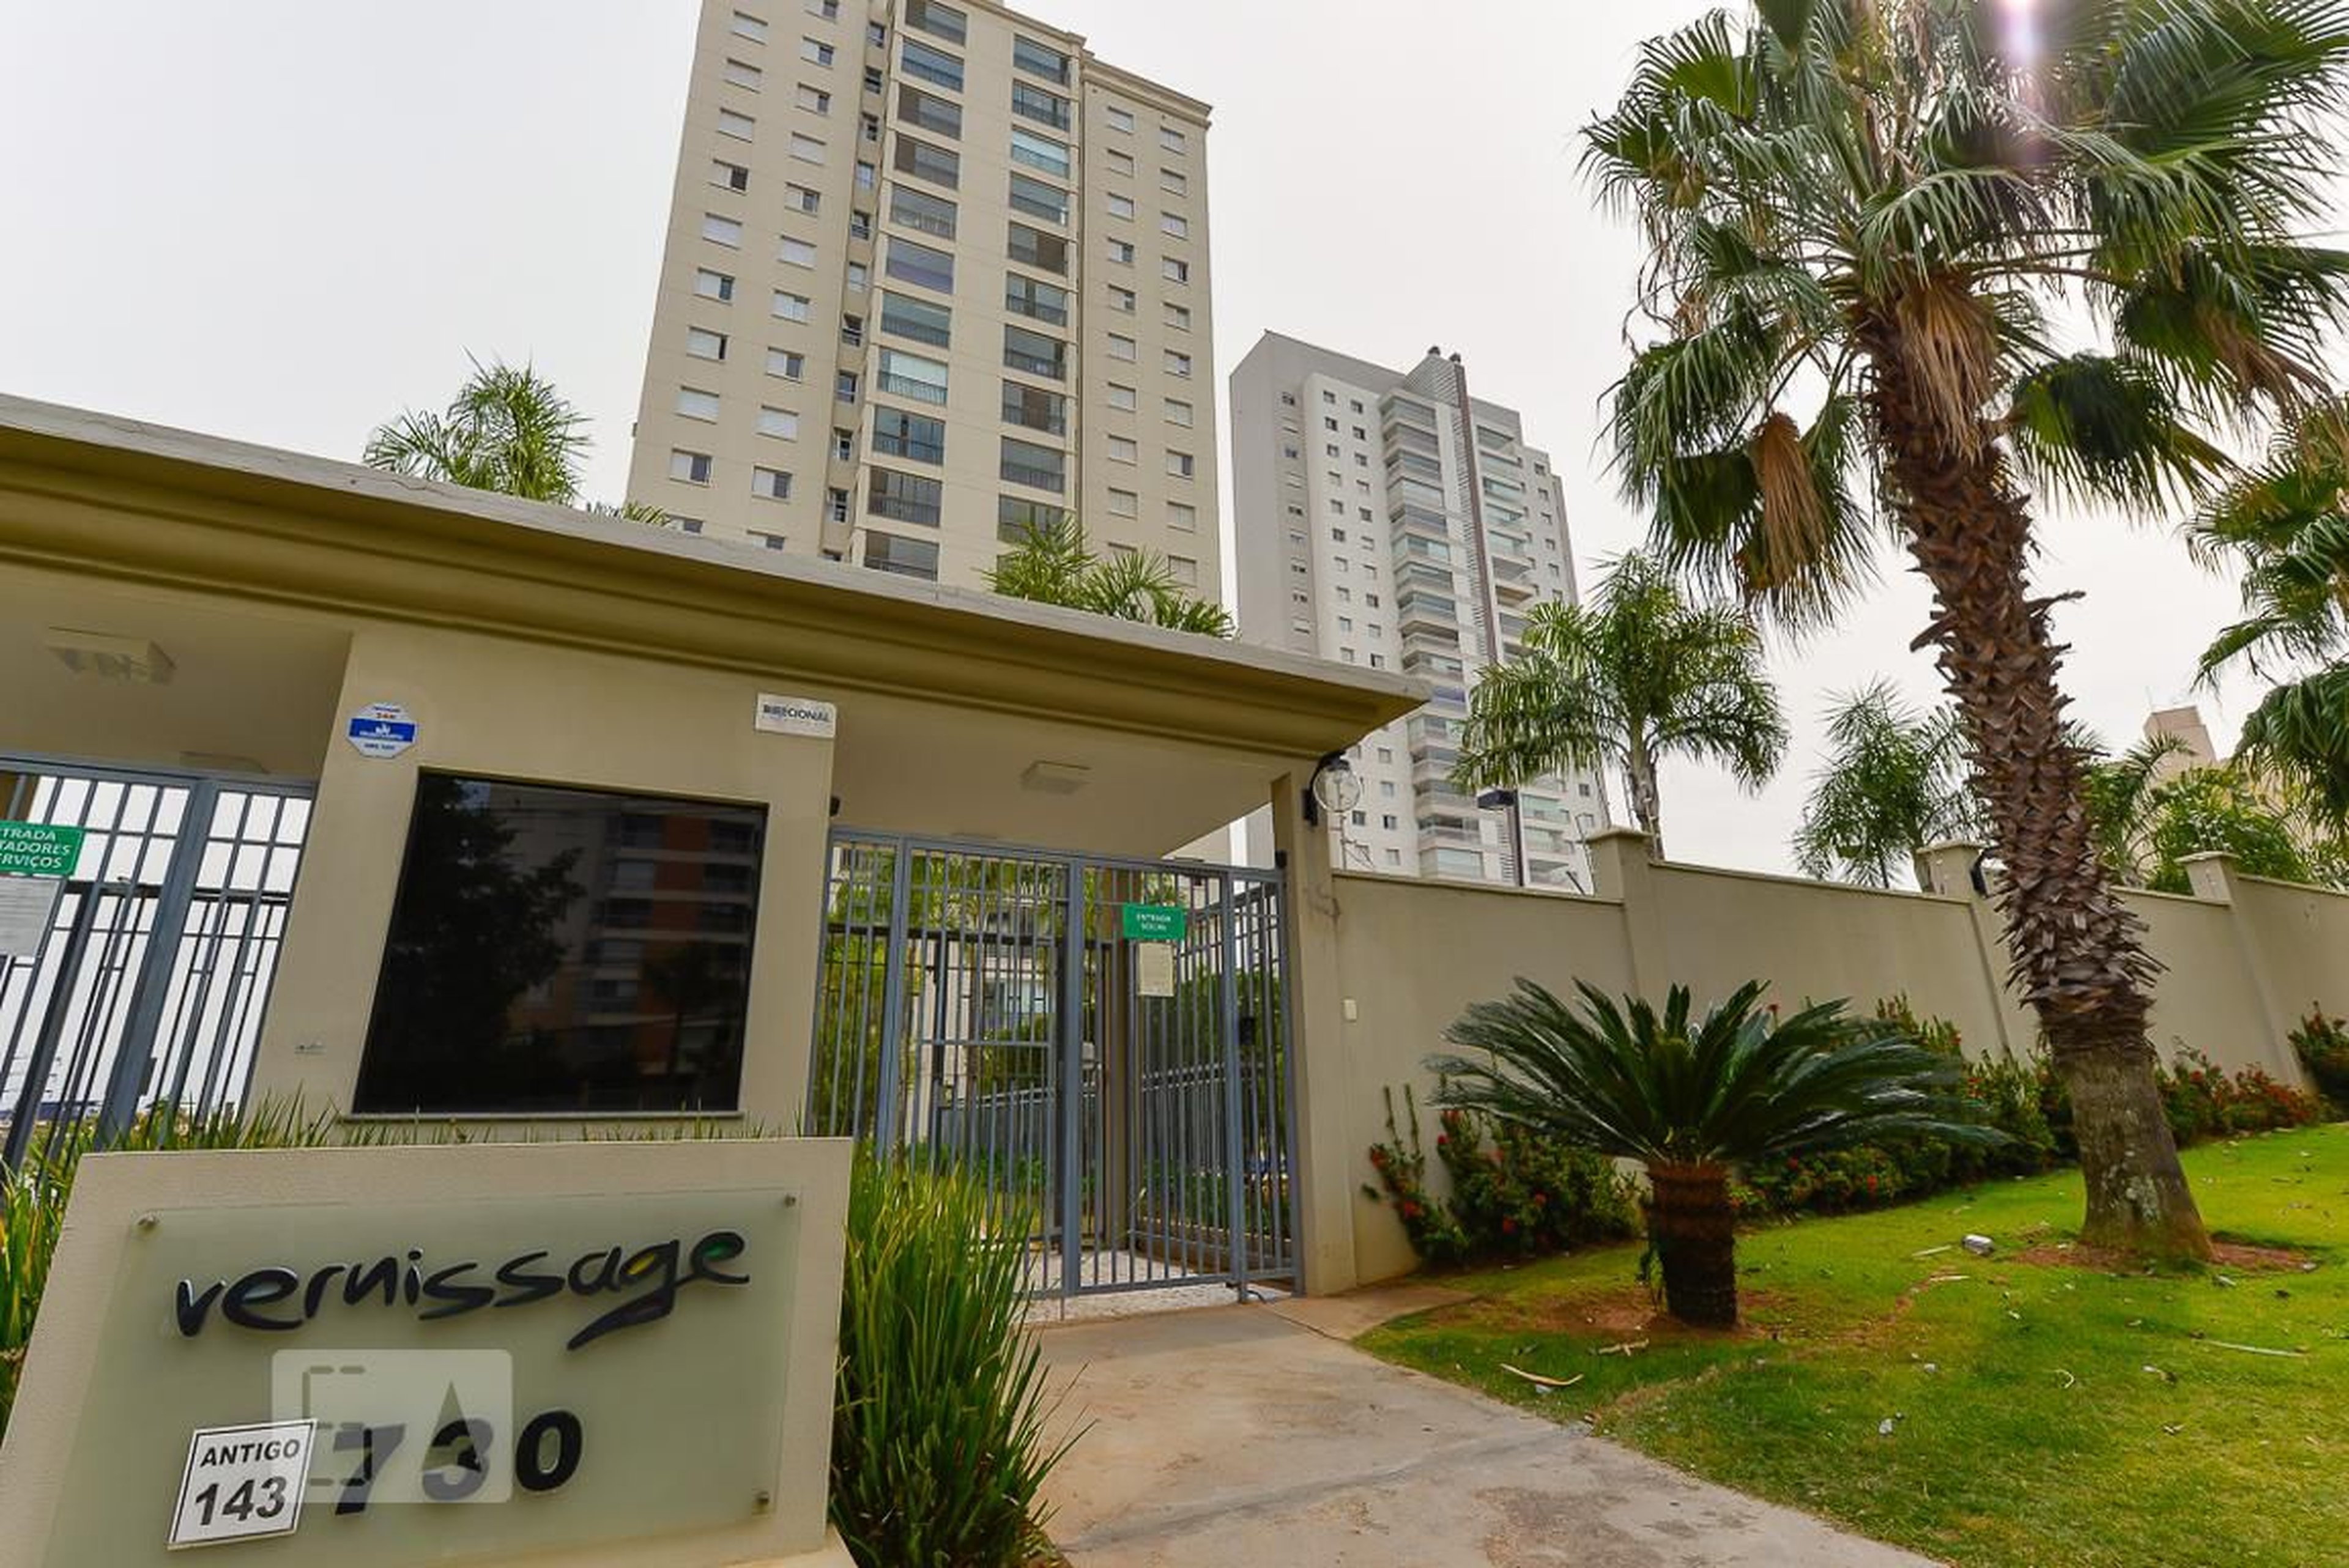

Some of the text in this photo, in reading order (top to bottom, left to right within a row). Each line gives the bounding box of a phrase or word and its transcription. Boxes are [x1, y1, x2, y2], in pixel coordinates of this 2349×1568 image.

[0, 827, 56, 841] TRADA
[176, 1230, 750, 1350] vernissage
[200, 1439, 300, 1467] ANTIGO
[333, 1410, 582, 1515] 730
[195, 1476, 286, 1526] 143
